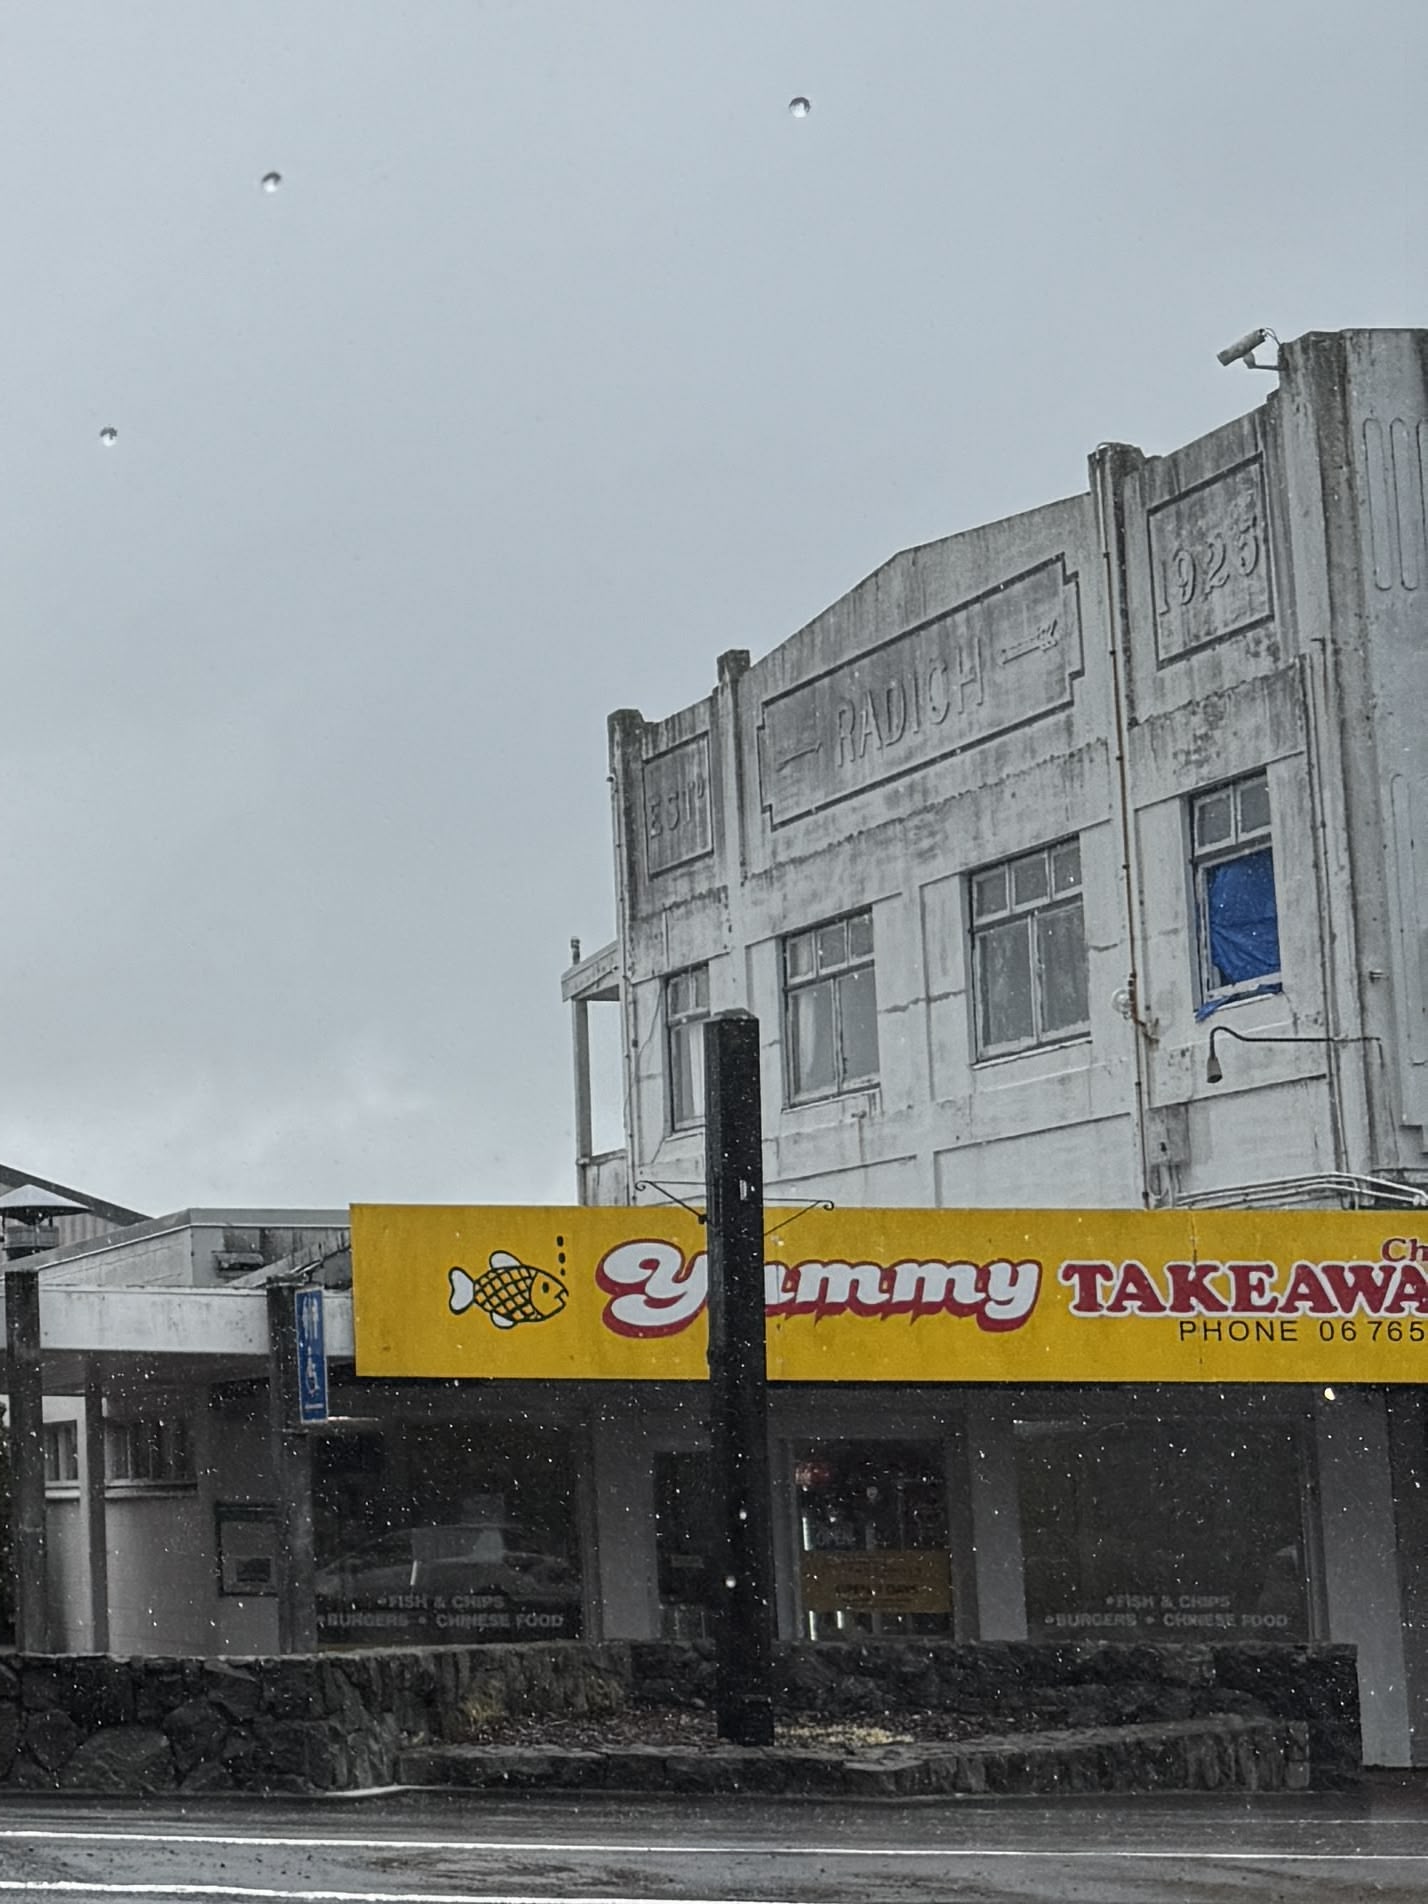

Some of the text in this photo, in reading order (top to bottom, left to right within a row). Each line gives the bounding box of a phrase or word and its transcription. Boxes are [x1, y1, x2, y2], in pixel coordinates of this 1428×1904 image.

[836, 634, 985, 769] RADICH
[1058, 1259, 1428, 1318] TAKEAWA
[1179, 1320, 1426, 1342] PHONE 06 765
[388, 1595, 429, 1610] FISH
[451, 1595, 506, 1610] CHIPS
[1178, 1595, 1231, 1609] CHIPS
[327, 1613, 565, 1629] BURGERS CHINESE FOOD
[1055, 1612, 1289, 1628] BURGERS CHINESE FOOD
